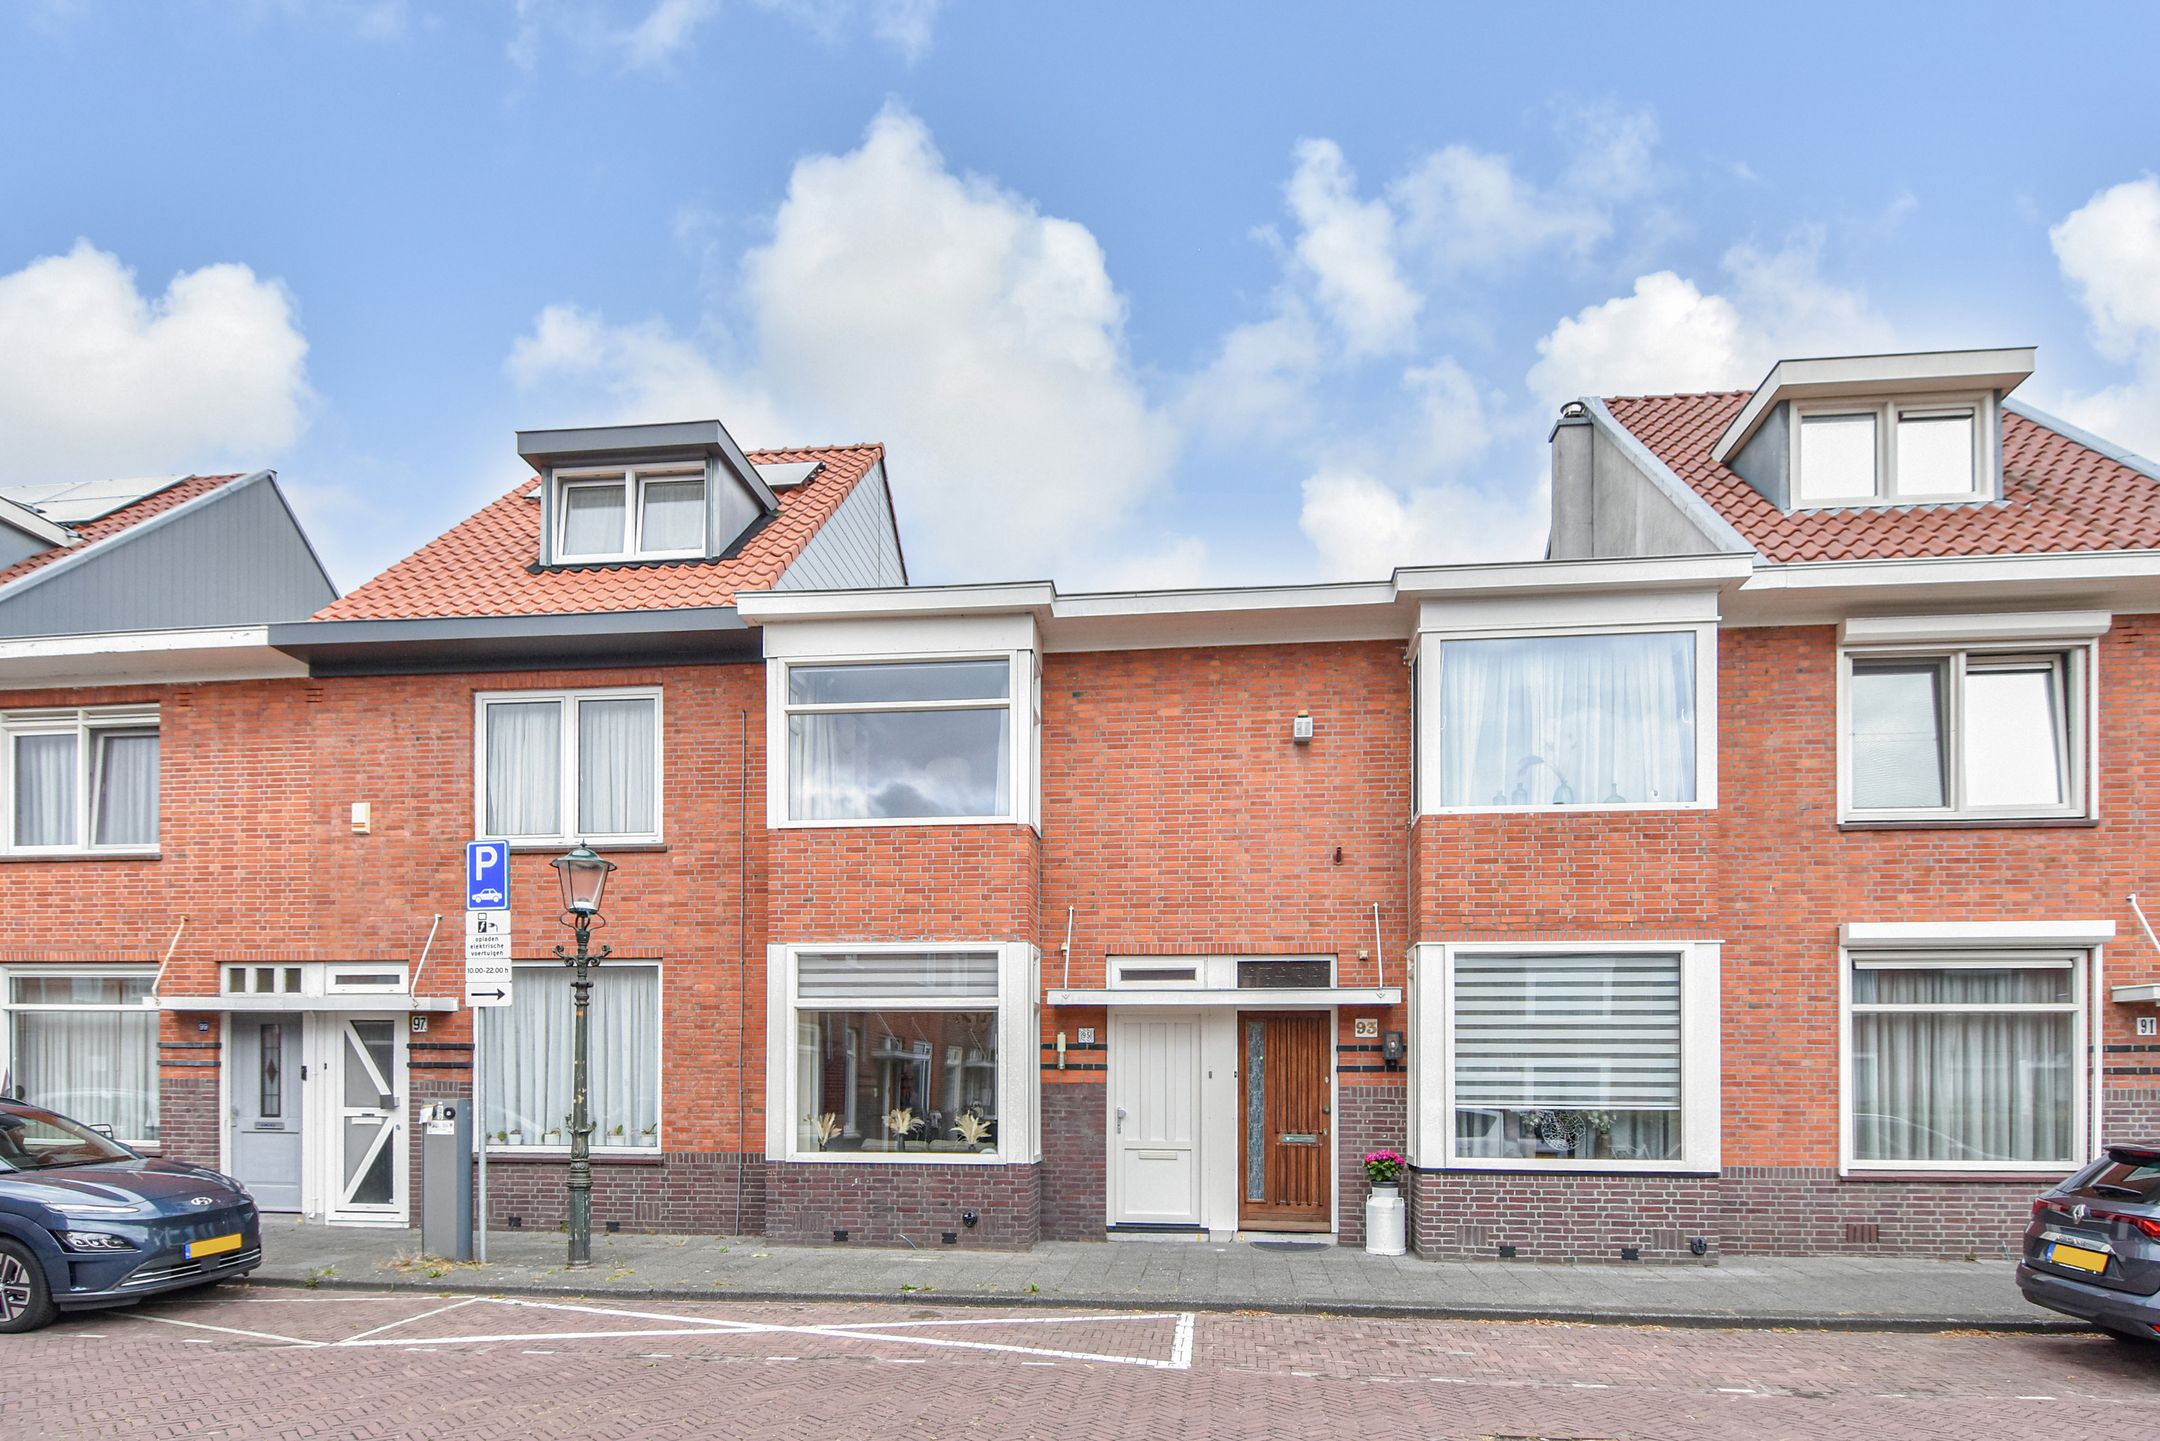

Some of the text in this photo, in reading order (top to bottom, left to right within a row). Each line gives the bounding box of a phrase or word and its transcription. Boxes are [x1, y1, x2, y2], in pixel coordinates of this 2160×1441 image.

[475, 846, 498, 881] P
[413, 1017, 426, 1030] 97
[1356, 1021, 1376, 1034] 93
[2140, 1019, 2154, 1033] 91
